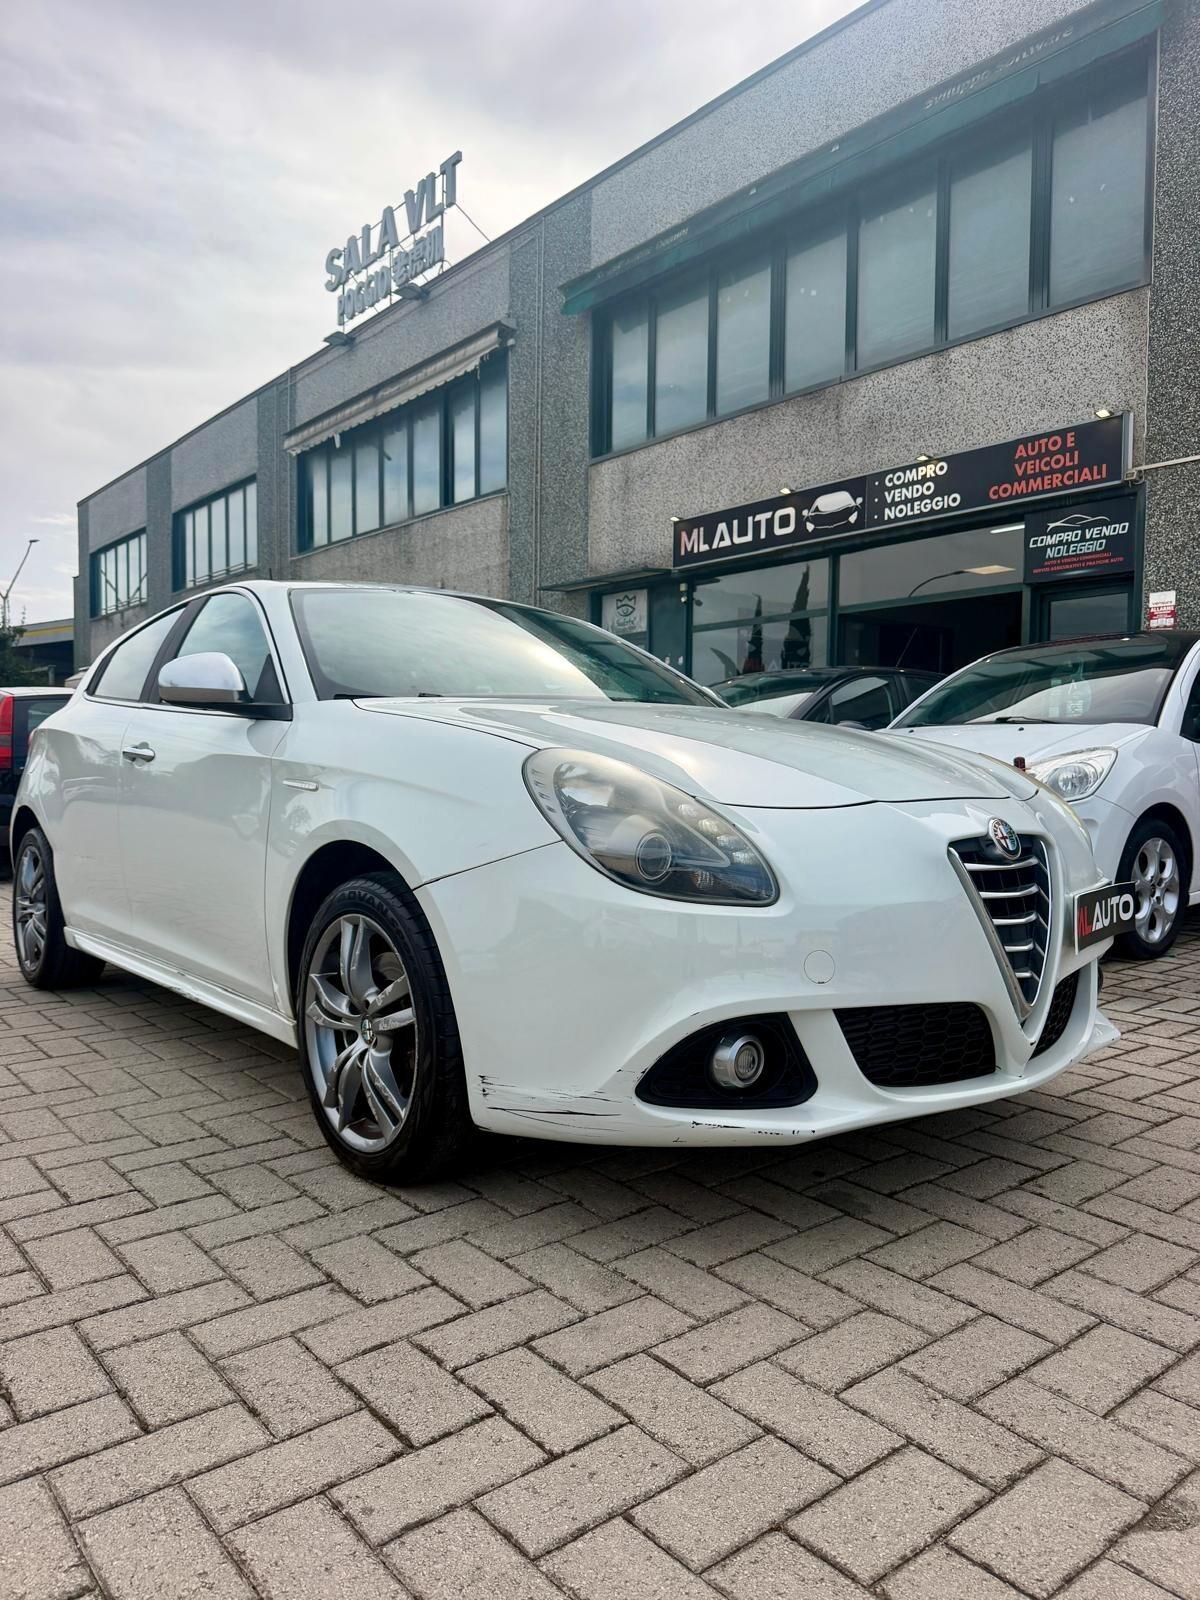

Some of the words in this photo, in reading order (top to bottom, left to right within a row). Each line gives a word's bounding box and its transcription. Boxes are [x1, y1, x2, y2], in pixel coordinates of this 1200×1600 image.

[325, 205, 401, 293] SALA
[403, 150, 463, 235] VLT
[337, 266, 391, 326] POGGIO
[1014, 435, 1062, 460] AUTO
[1066, 432, 1076, 448] E
[884, 461, 948, 488] COMPRO
[1014, 451, 1079, 477] VEICOLI
[884, 482, 935, 504] VENDO
[988, 463, 1108, 500] COMMERCIALI
[884, 493, 961, 520] NOLEGGIO
[1029, 530, 1082, 548] COMPRO
[1085, 522, 1129, 540] VENDO
[1045, 539, 1106, 559] NOLEGGIO
